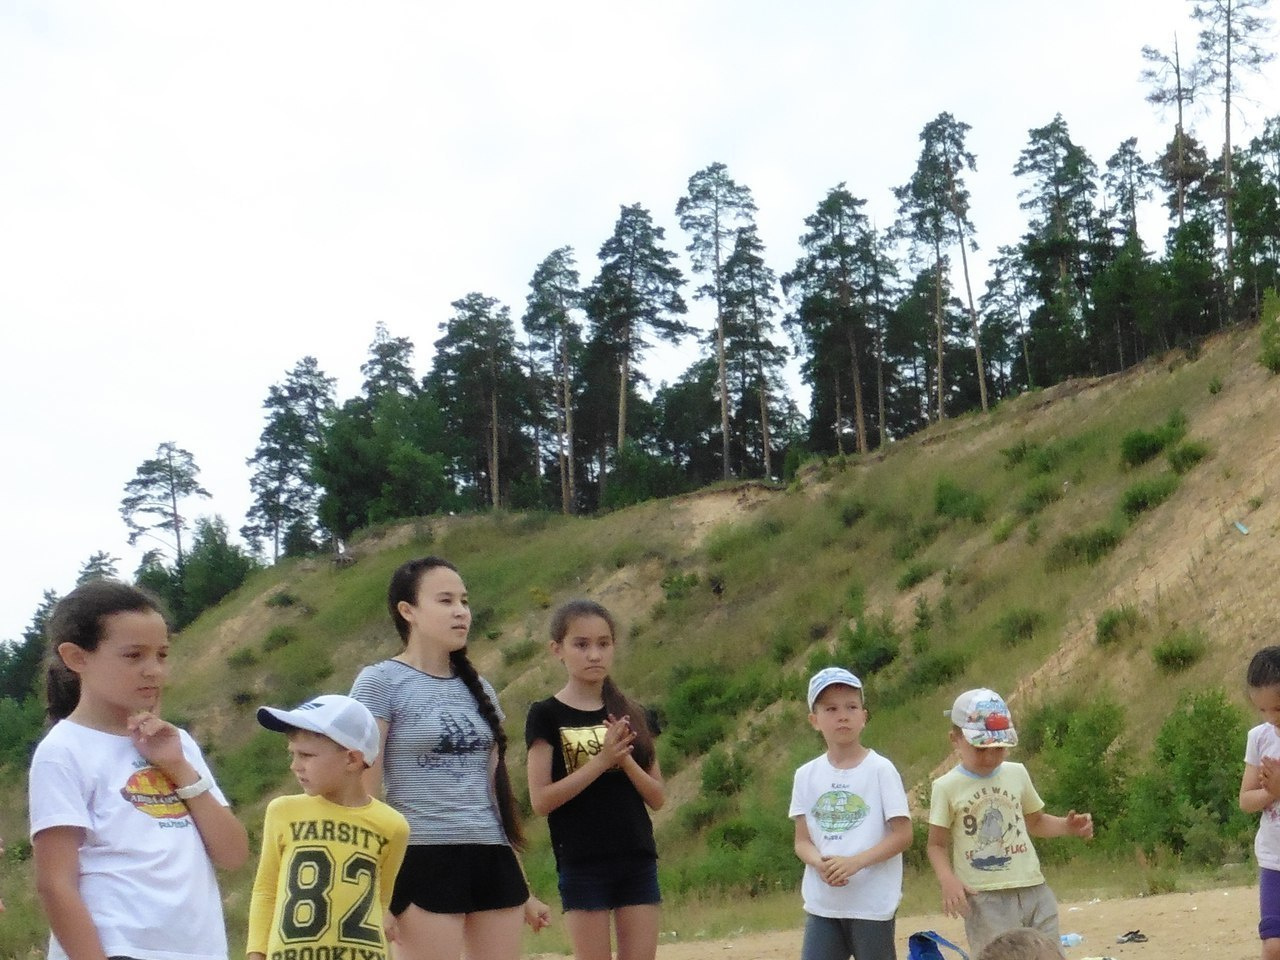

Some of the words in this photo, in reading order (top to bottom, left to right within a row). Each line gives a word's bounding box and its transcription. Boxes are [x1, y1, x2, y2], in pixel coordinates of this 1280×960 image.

[963, 788, 987, 814] BLUE
[992, 786, 1022, 811] WAYS
[289, 818, 391, 855] VARSITY
[963, 814, 978, 836] 9
[278, 844, 385, 950] 82
